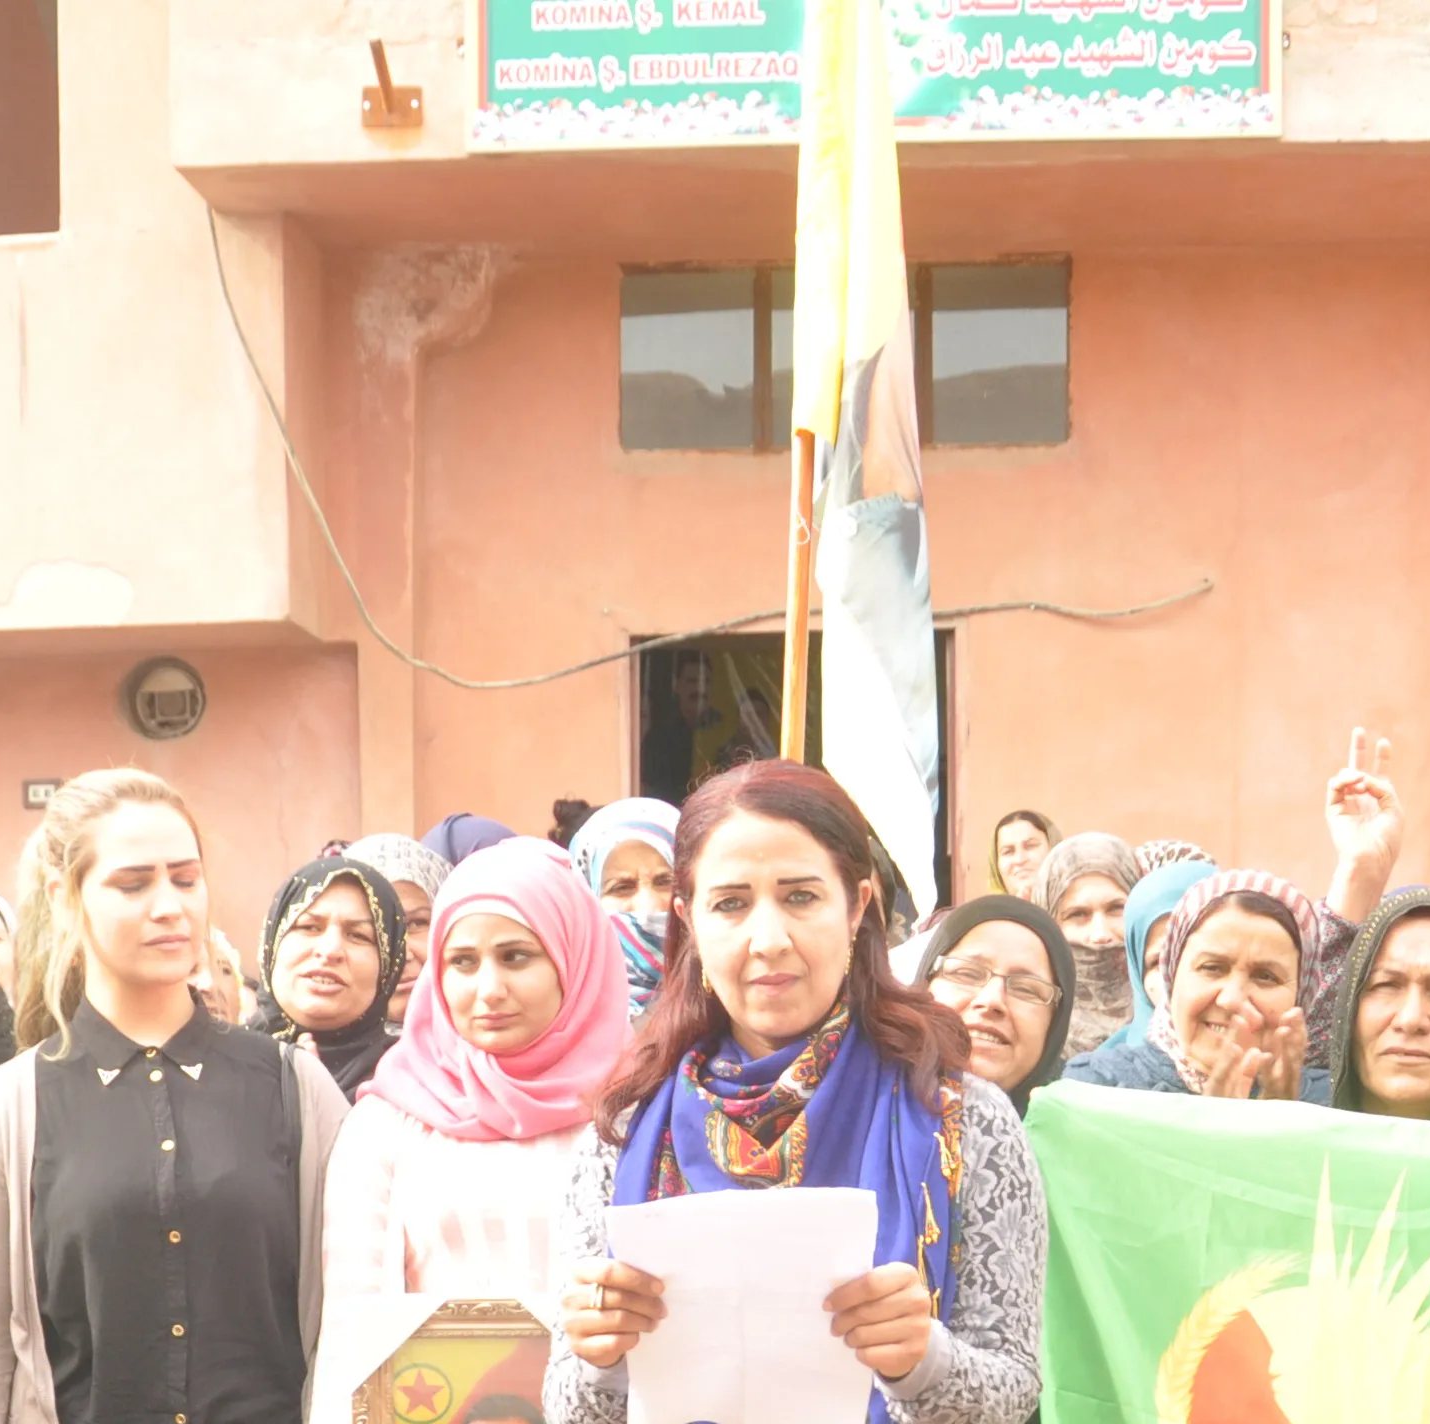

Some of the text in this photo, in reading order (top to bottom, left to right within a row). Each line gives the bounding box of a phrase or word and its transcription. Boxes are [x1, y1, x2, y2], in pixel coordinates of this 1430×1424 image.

[677, 1, 763, 22] KEMAL
[1009, 42, 1058, 73] عبد
[1067, 31, 1155, 72] الشهيد
